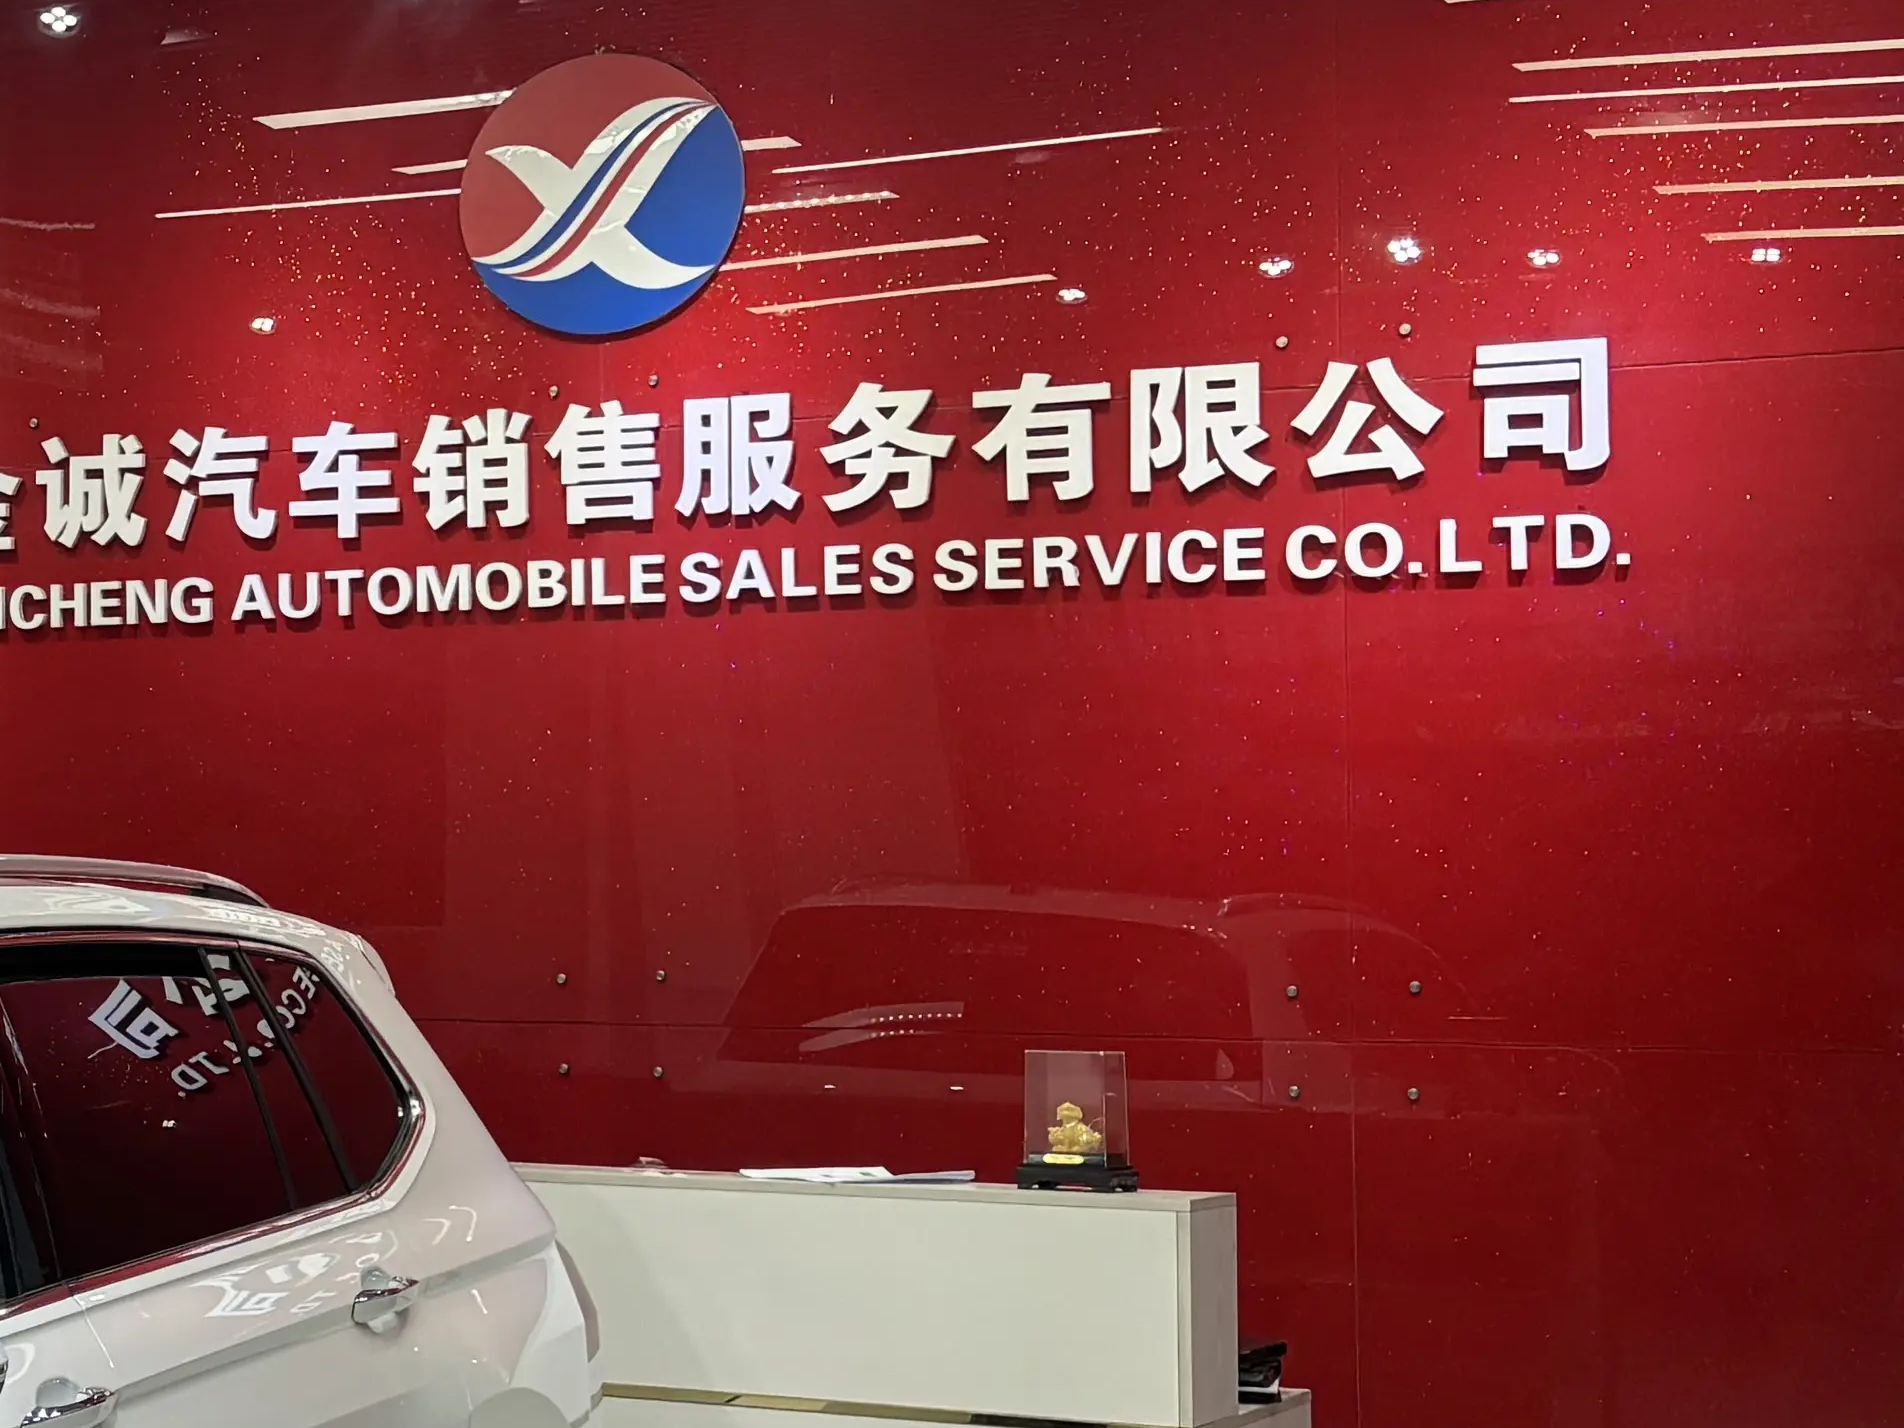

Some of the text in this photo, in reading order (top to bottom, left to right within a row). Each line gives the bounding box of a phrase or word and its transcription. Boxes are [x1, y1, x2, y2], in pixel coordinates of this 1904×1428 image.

[230, 553, 666, 624] AUTOMOBILE
[679, 542, 914, 603] SALES
[933, 527, 1266, 593] SERVICE
